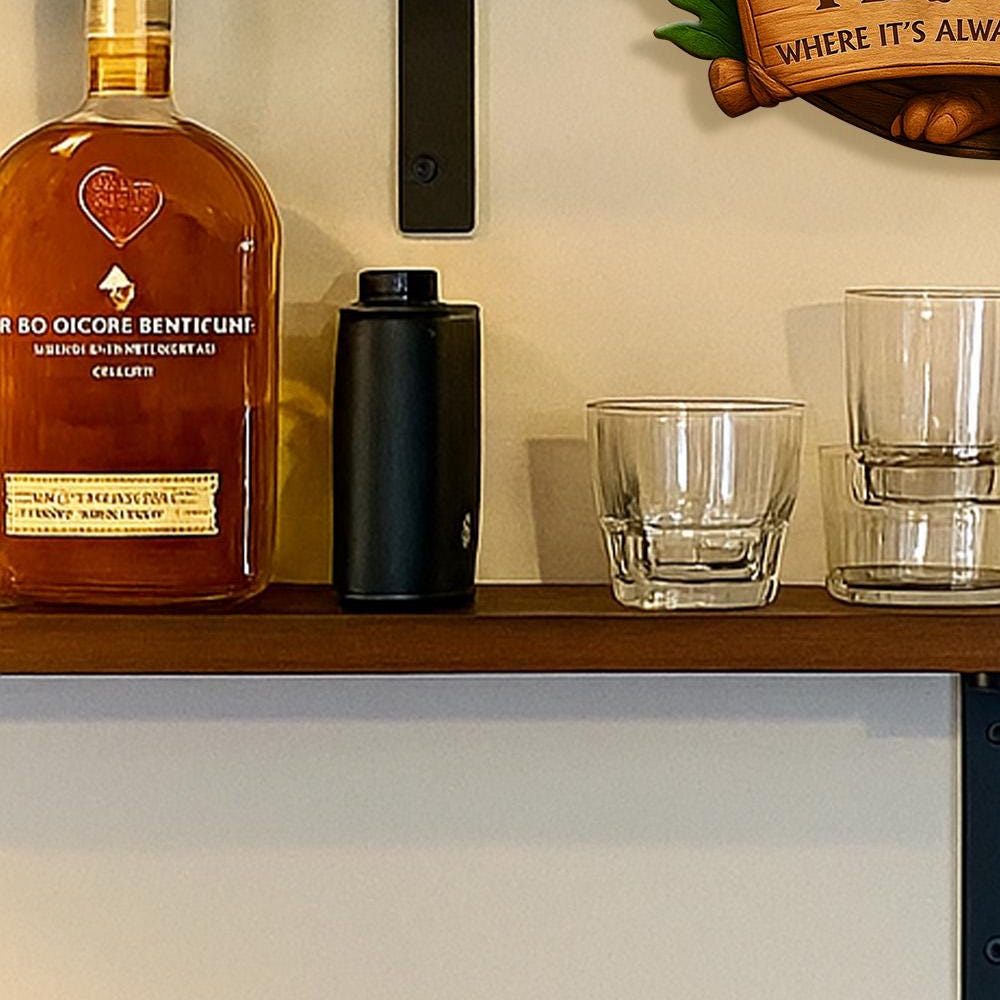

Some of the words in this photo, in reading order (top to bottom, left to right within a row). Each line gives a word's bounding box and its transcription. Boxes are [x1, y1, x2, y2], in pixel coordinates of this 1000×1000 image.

[775, 26, 871, 66] WHERE
[879, 20, 926, 47] IT'S
[18, 317, 47, 334] BO
